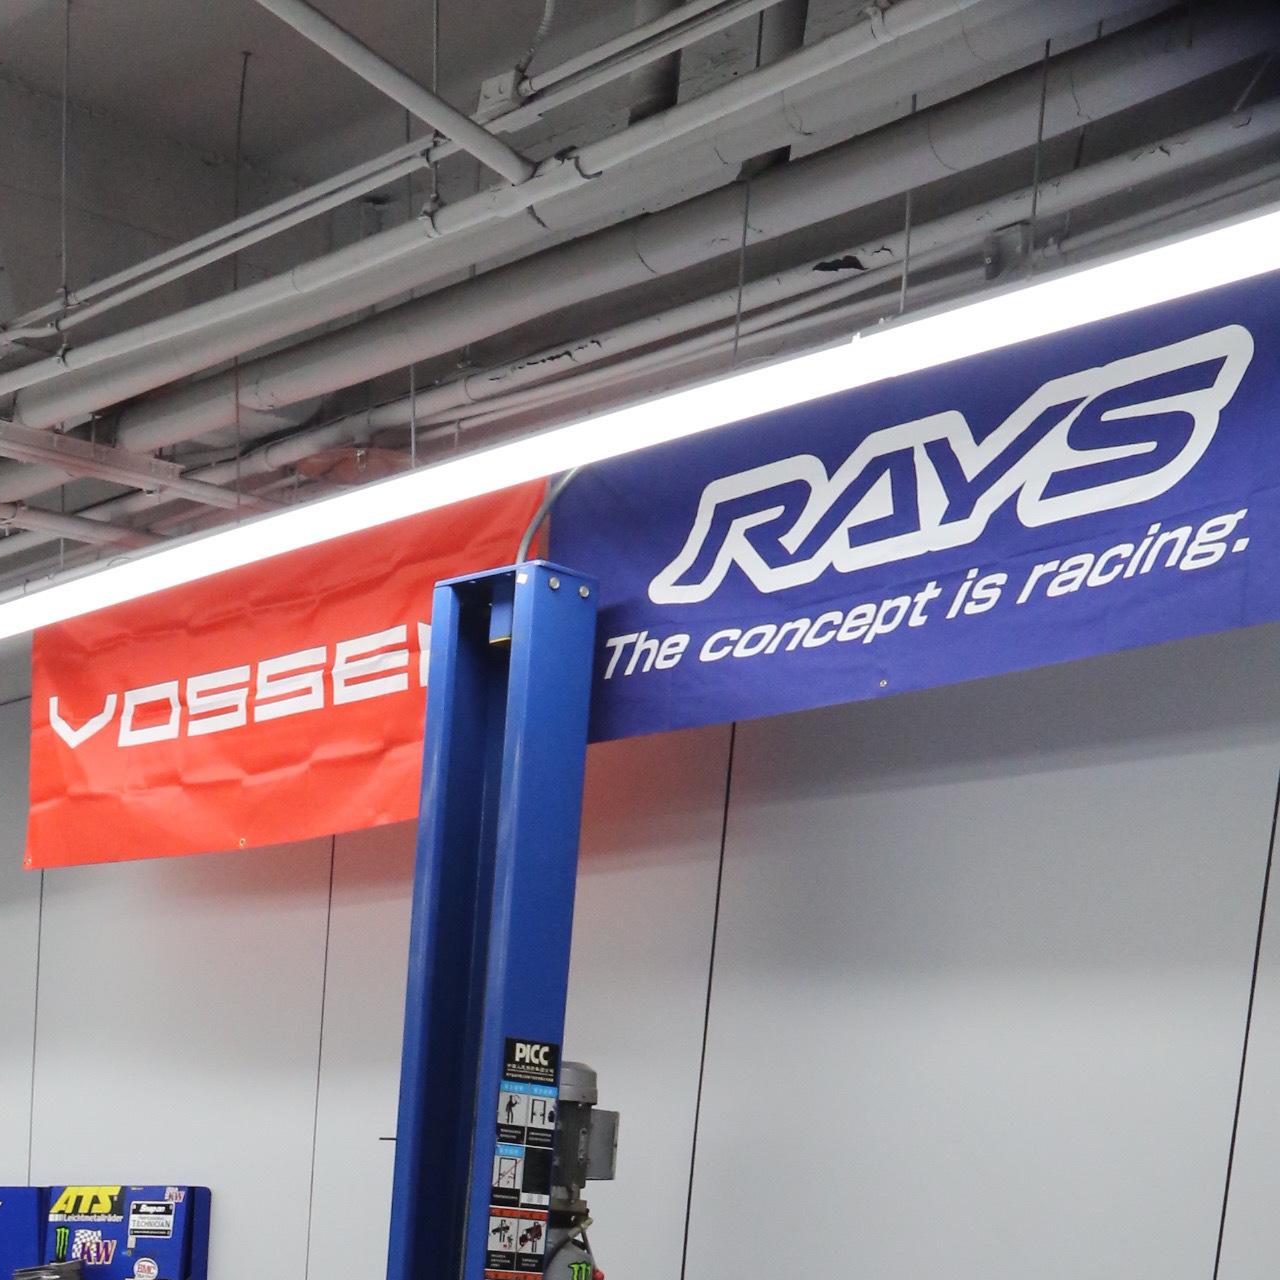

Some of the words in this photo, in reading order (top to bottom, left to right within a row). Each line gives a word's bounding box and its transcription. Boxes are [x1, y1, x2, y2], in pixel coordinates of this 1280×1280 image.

[648, 324, 1254, 604] RAYS
[604, 632, 682, 679] The
[699, 588, 932, 662] concept
[945, 568, 1005, 619] is
[1016, 508, 1248, 604] racing.
[515, 1043, 549, 1066] PICC
[49, 1186, 121, 1213] ATS
